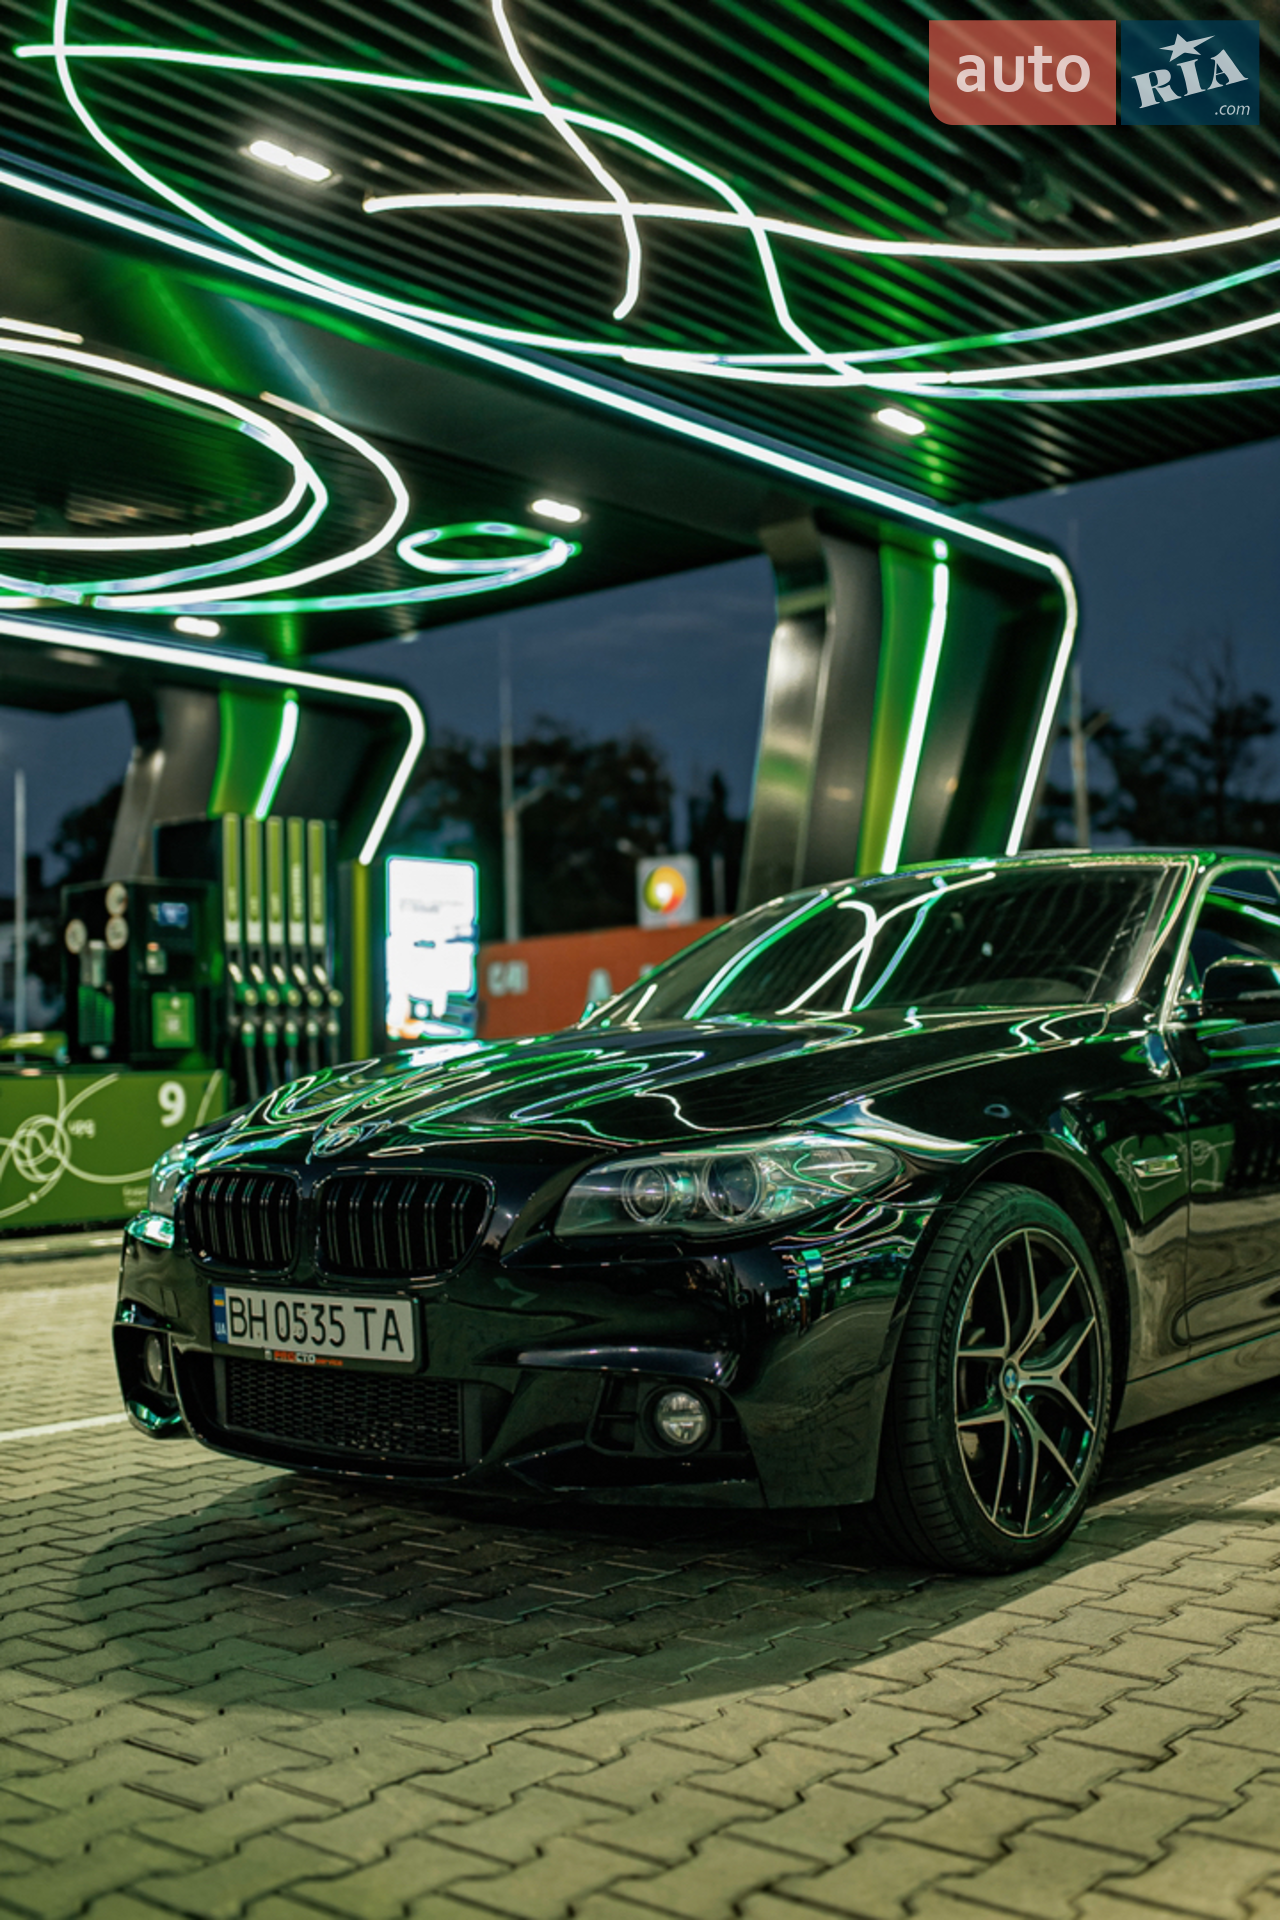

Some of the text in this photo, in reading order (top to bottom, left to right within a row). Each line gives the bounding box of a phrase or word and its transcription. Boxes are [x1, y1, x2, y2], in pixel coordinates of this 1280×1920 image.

[158, 1081, 186, 1127] 9
[214, 1322, 226, 1336] UA
[228, 1296, 405, 1352] BH 0535 TA
